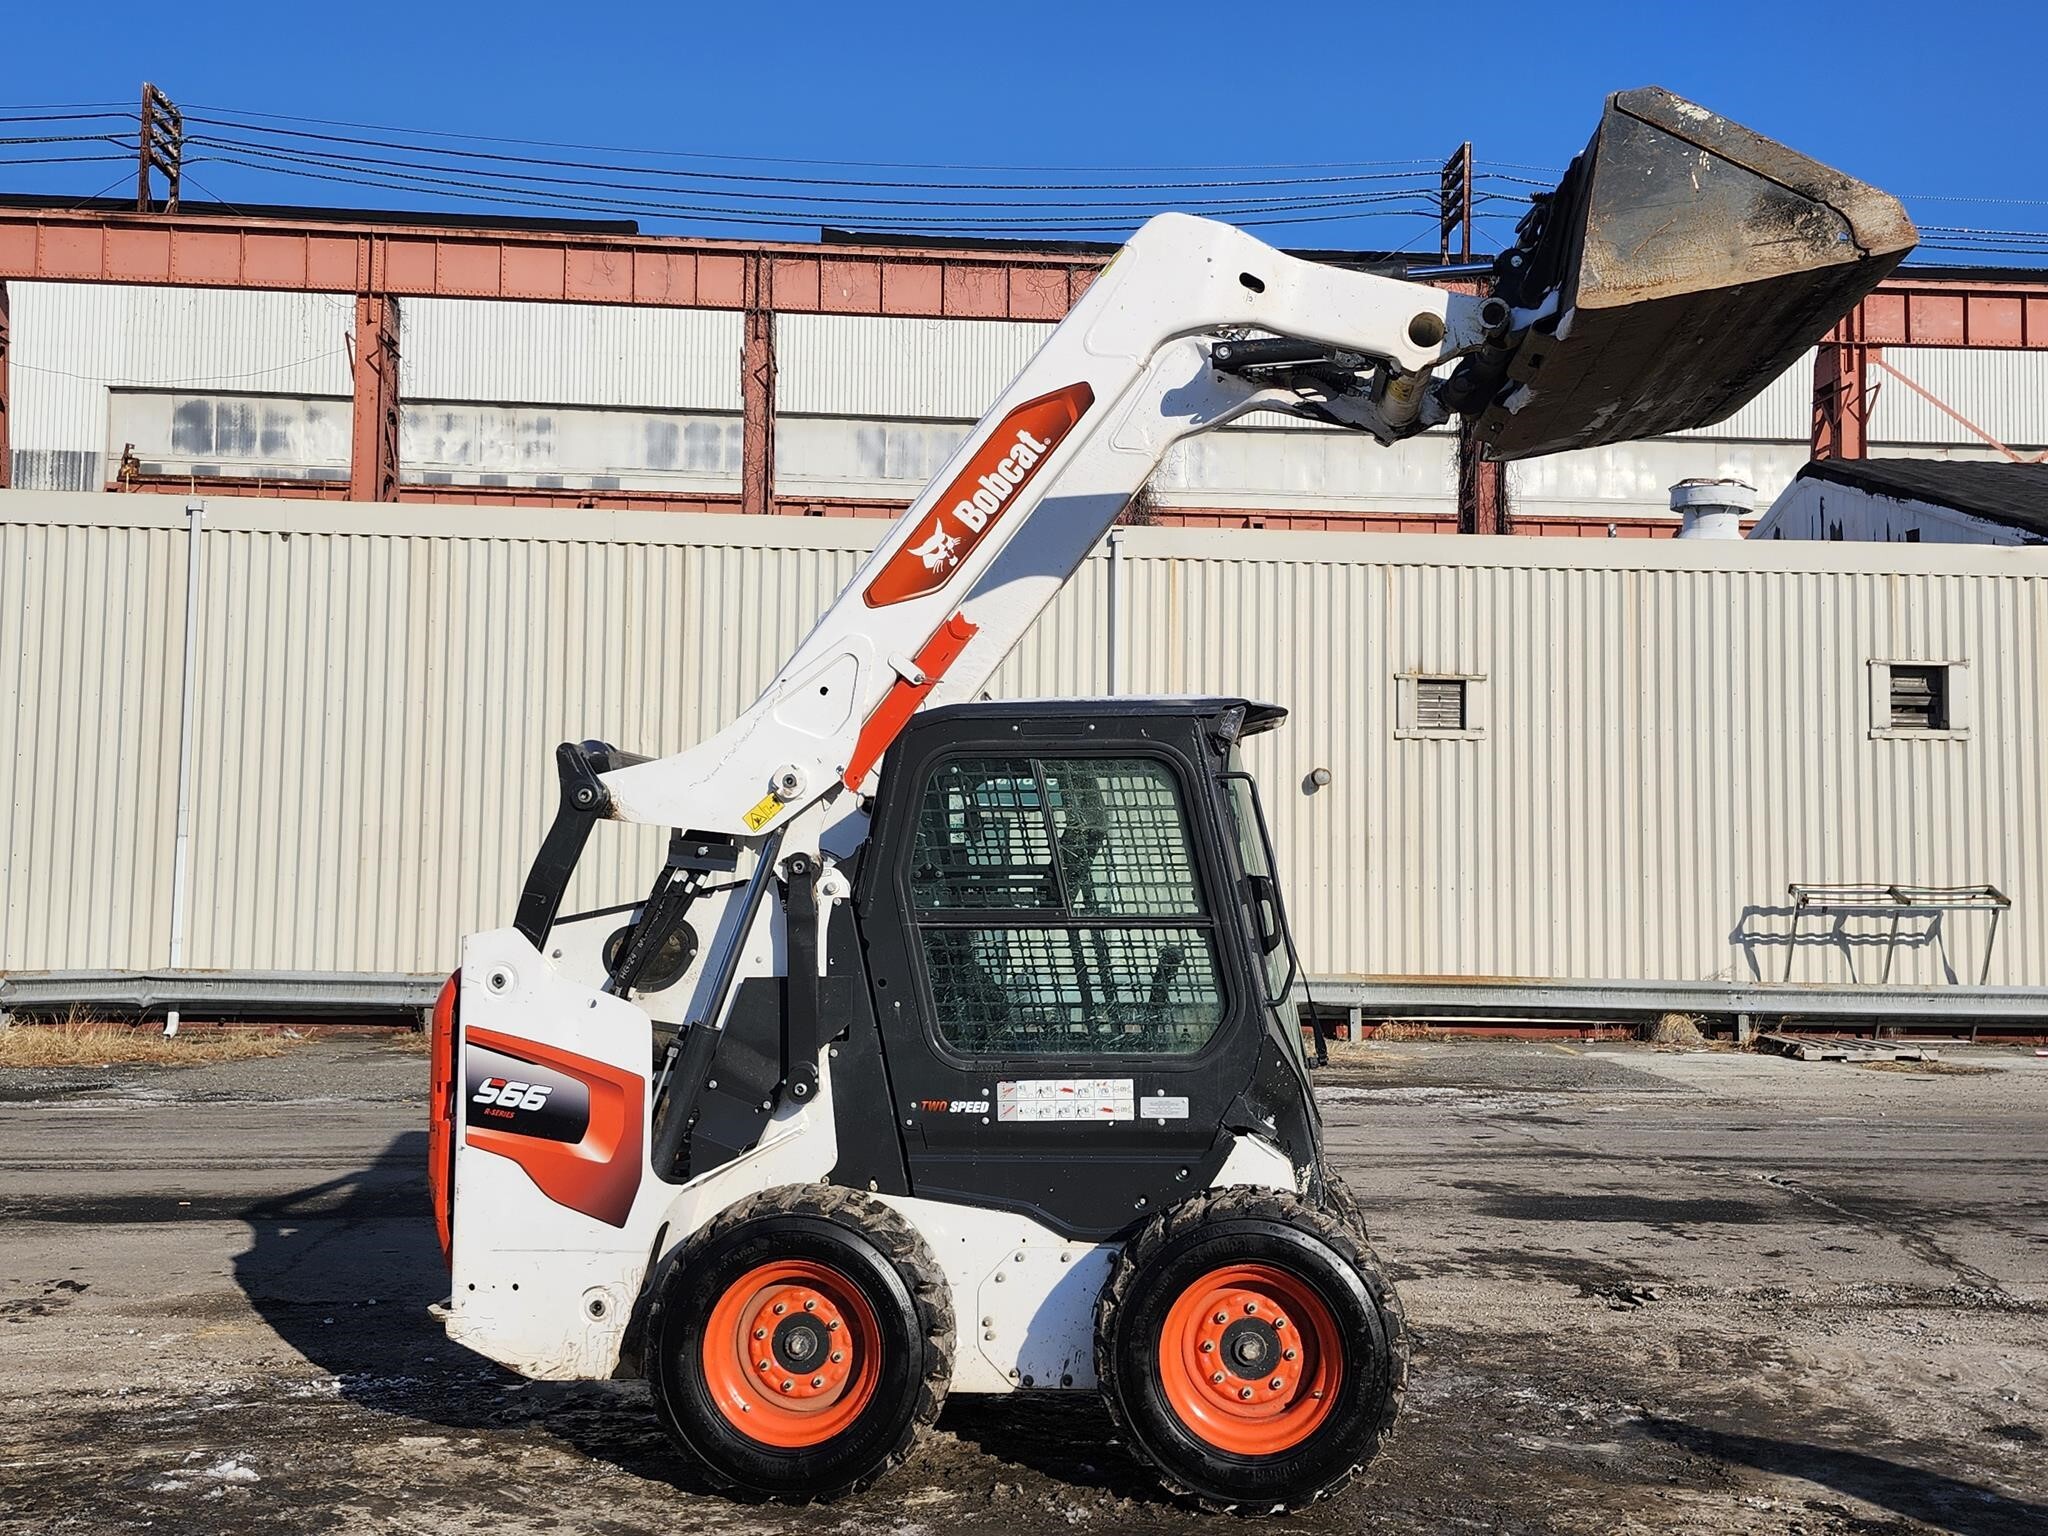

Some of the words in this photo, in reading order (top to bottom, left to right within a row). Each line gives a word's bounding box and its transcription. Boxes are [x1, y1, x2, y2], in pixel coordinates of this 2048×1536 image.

[952, 429, 1047, 533] Bobcat
[473, 1078, 553, 1111] S66
[484, 1107, 515, 1119] R-SERIES
[921, 1100, 948, 1112] TWO
[949, 1101, 990, 1113] SPEED
